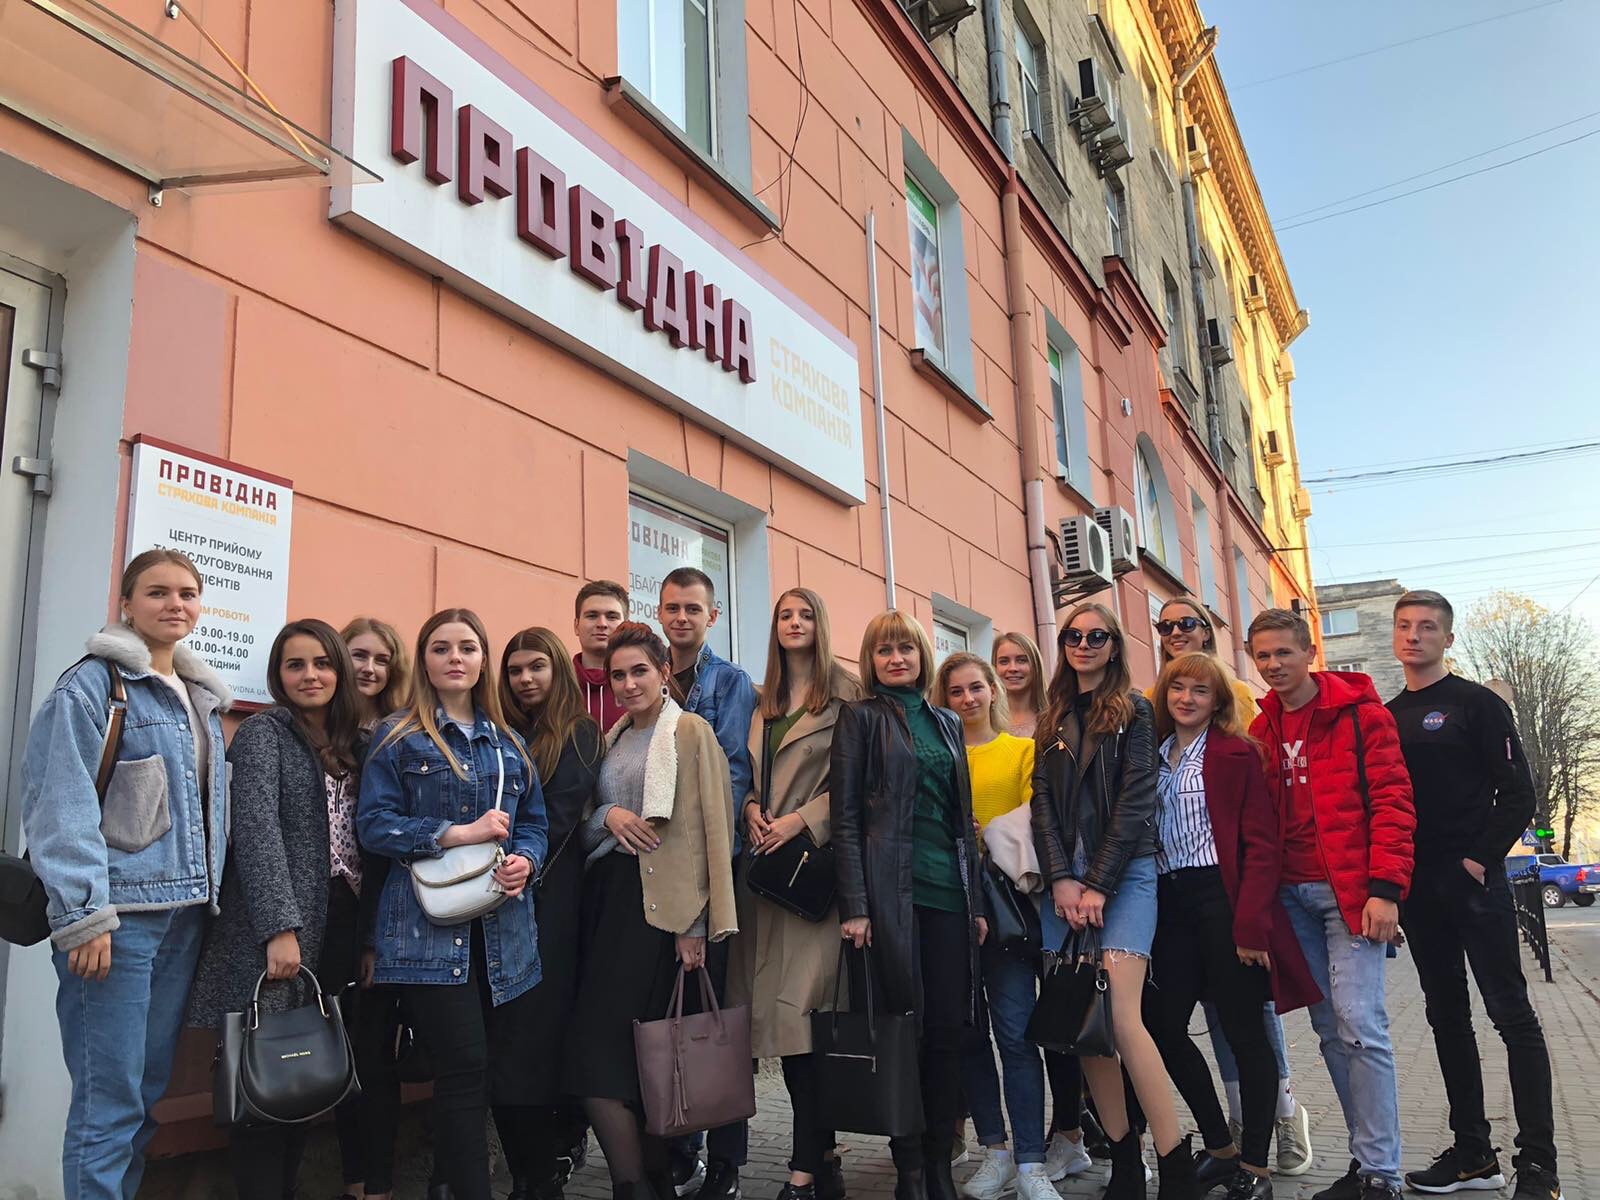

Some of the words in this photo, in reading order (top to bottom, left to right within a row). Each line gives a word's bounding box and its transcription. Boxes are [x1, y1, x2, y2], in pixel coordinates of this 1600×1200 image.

[392, 55, 757, 384] ПРОВІДНА
[769, 337, 850, 417] СТРАХОВА
[771, 371, 853, 449] КОМПАНІЯ
[159, 459, 278, 510] ПРОВІДНА
[158, 482, 219, 511] СТРАХОВА
[221, 499, 278, 526] КОМПАНІЯ
[169, 528, 207, 547] ЦЕНТР
[209, 538, 263, 561] ПРИЙОМУ
[630, 520, 689, 561] ОВІДНА
[199, 572, 241, 591] ЛІЄНТІВ
[212, 607, 251, 622] РОБОТИ
[188, 639, 249, 659] 10.00-14.00
[201, 625, 255, 645] 9.00-19.00
[204, 657, 241, 672] хідний
